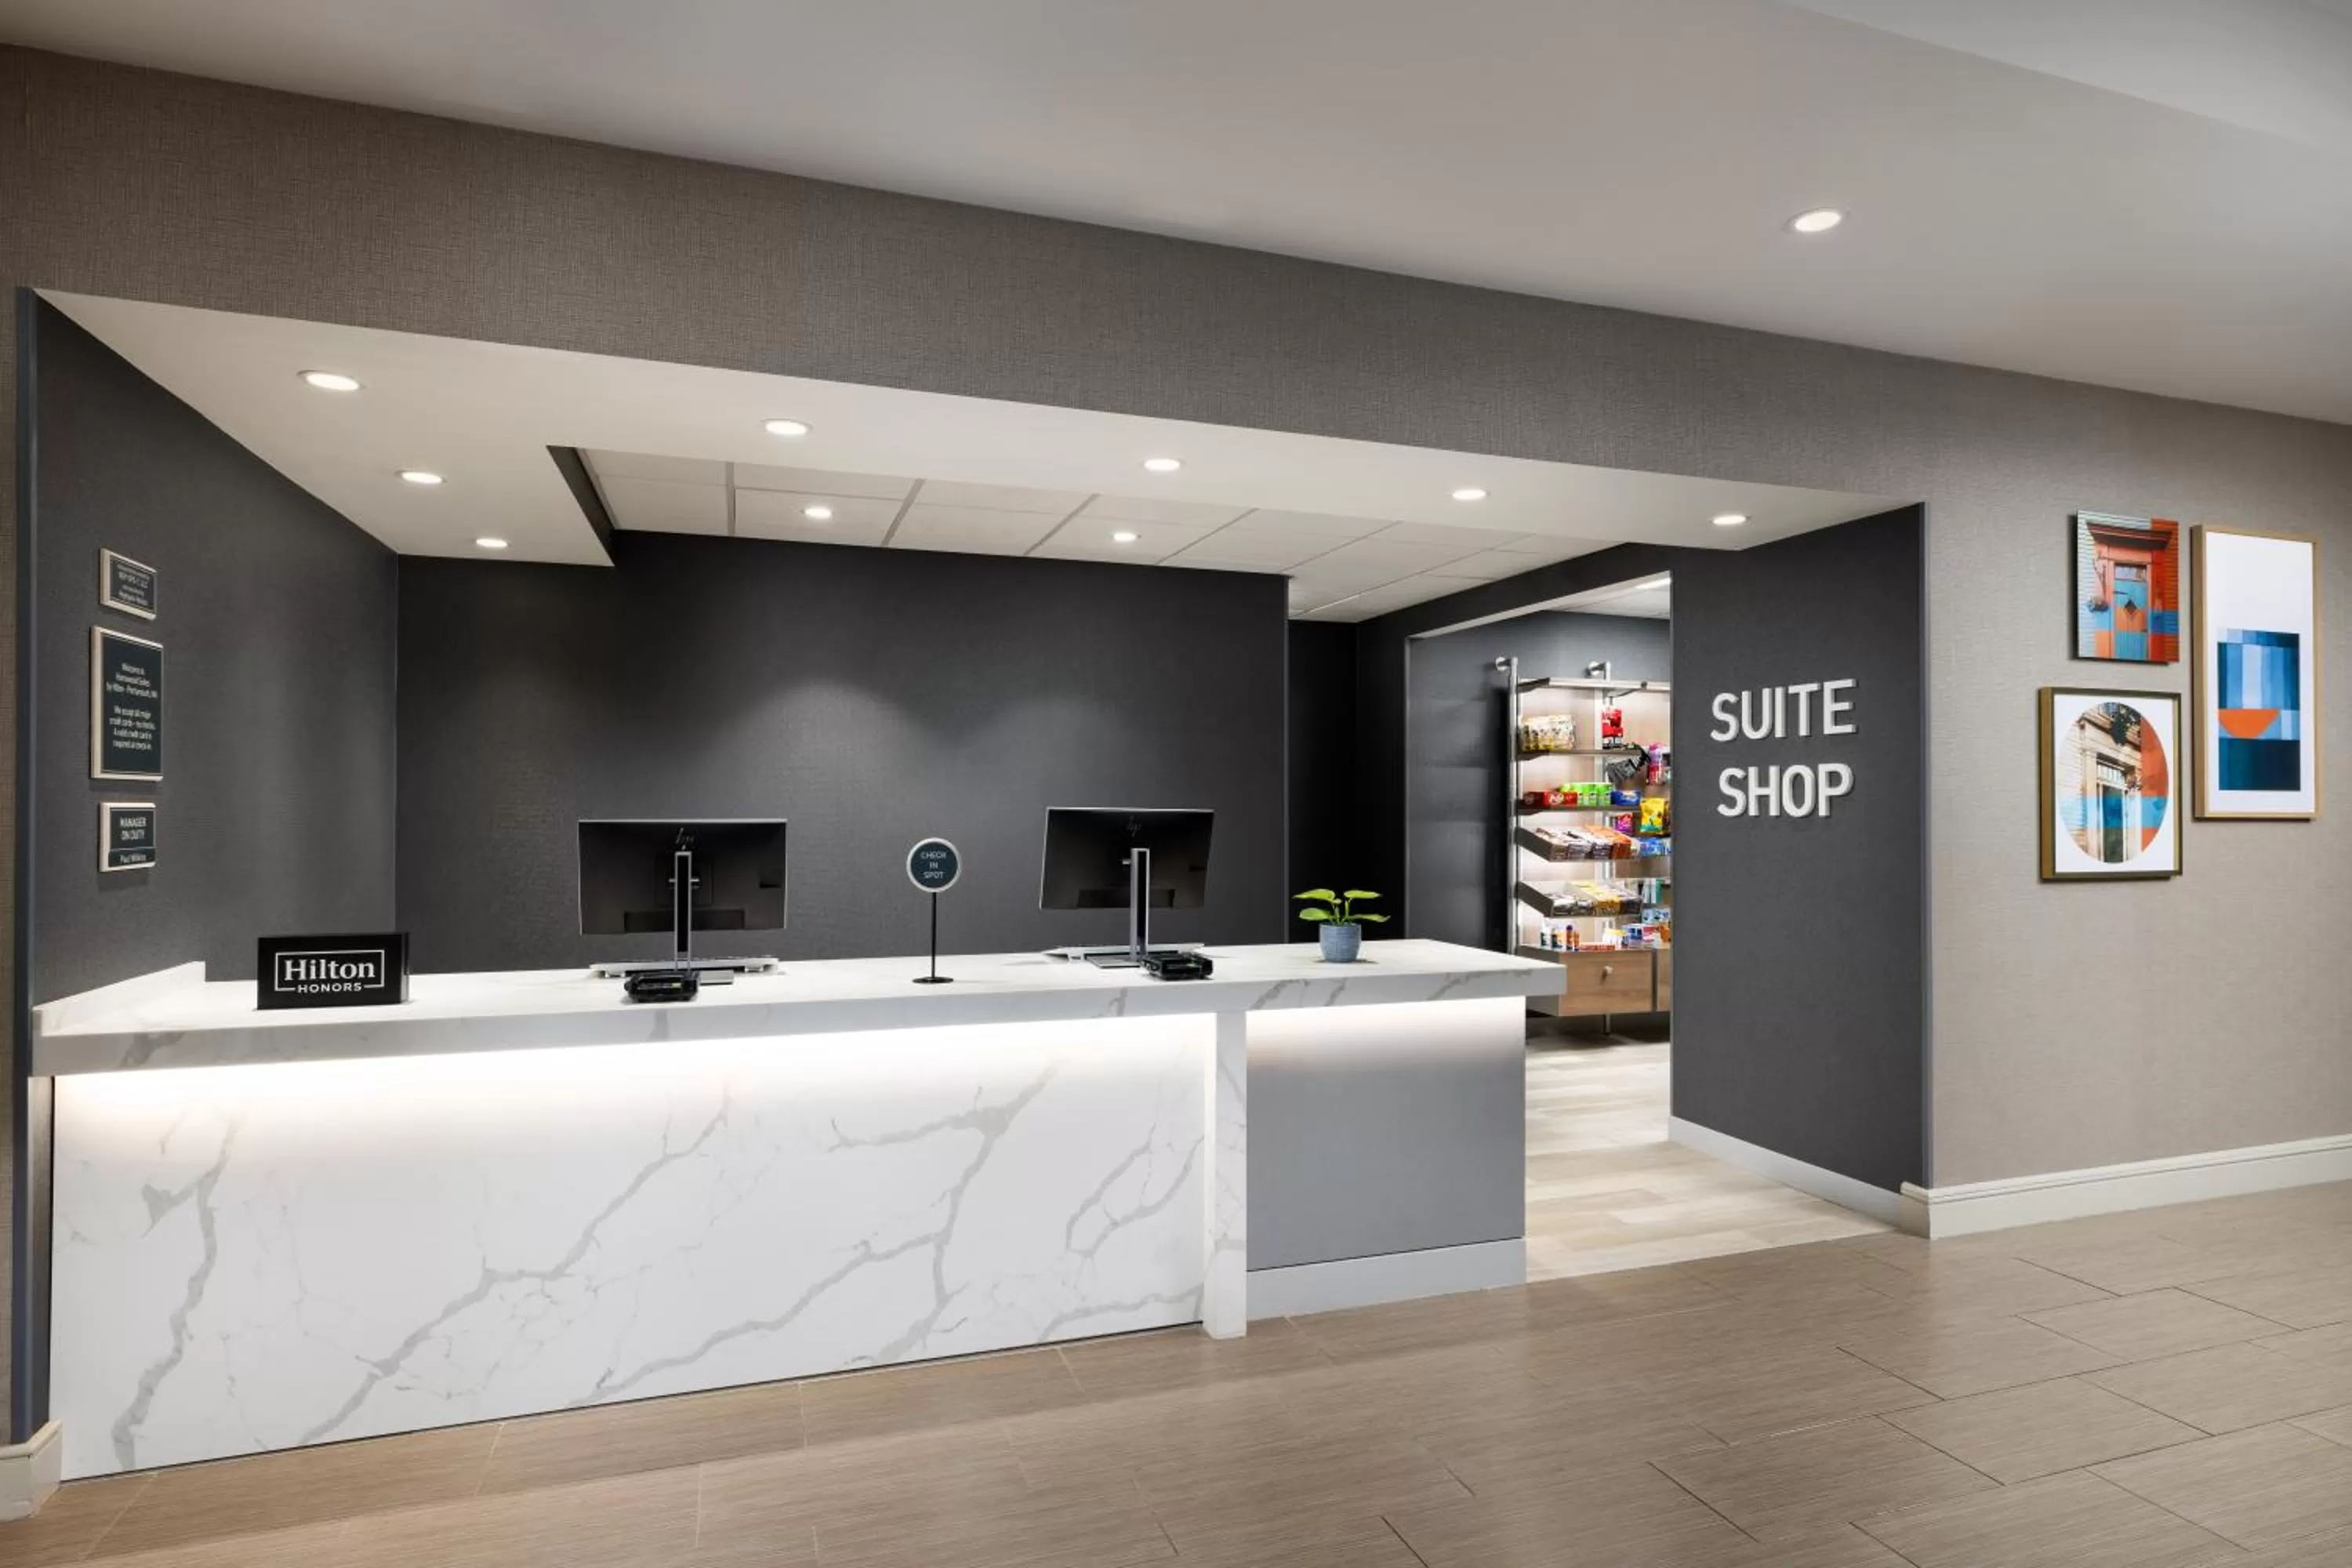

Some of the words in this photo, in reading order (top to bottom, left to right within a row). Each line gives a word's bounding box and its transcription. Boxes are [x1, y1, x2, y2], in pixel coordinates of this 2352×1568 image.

[1710, 678, 1857, 742] SUITE
[1717, 763, 1854, 818] SHOP
[920, 851, 947, 860] CHECK
[284, 958, 376, 982] Hilton
[297, 982, 362, 994] HONORS
